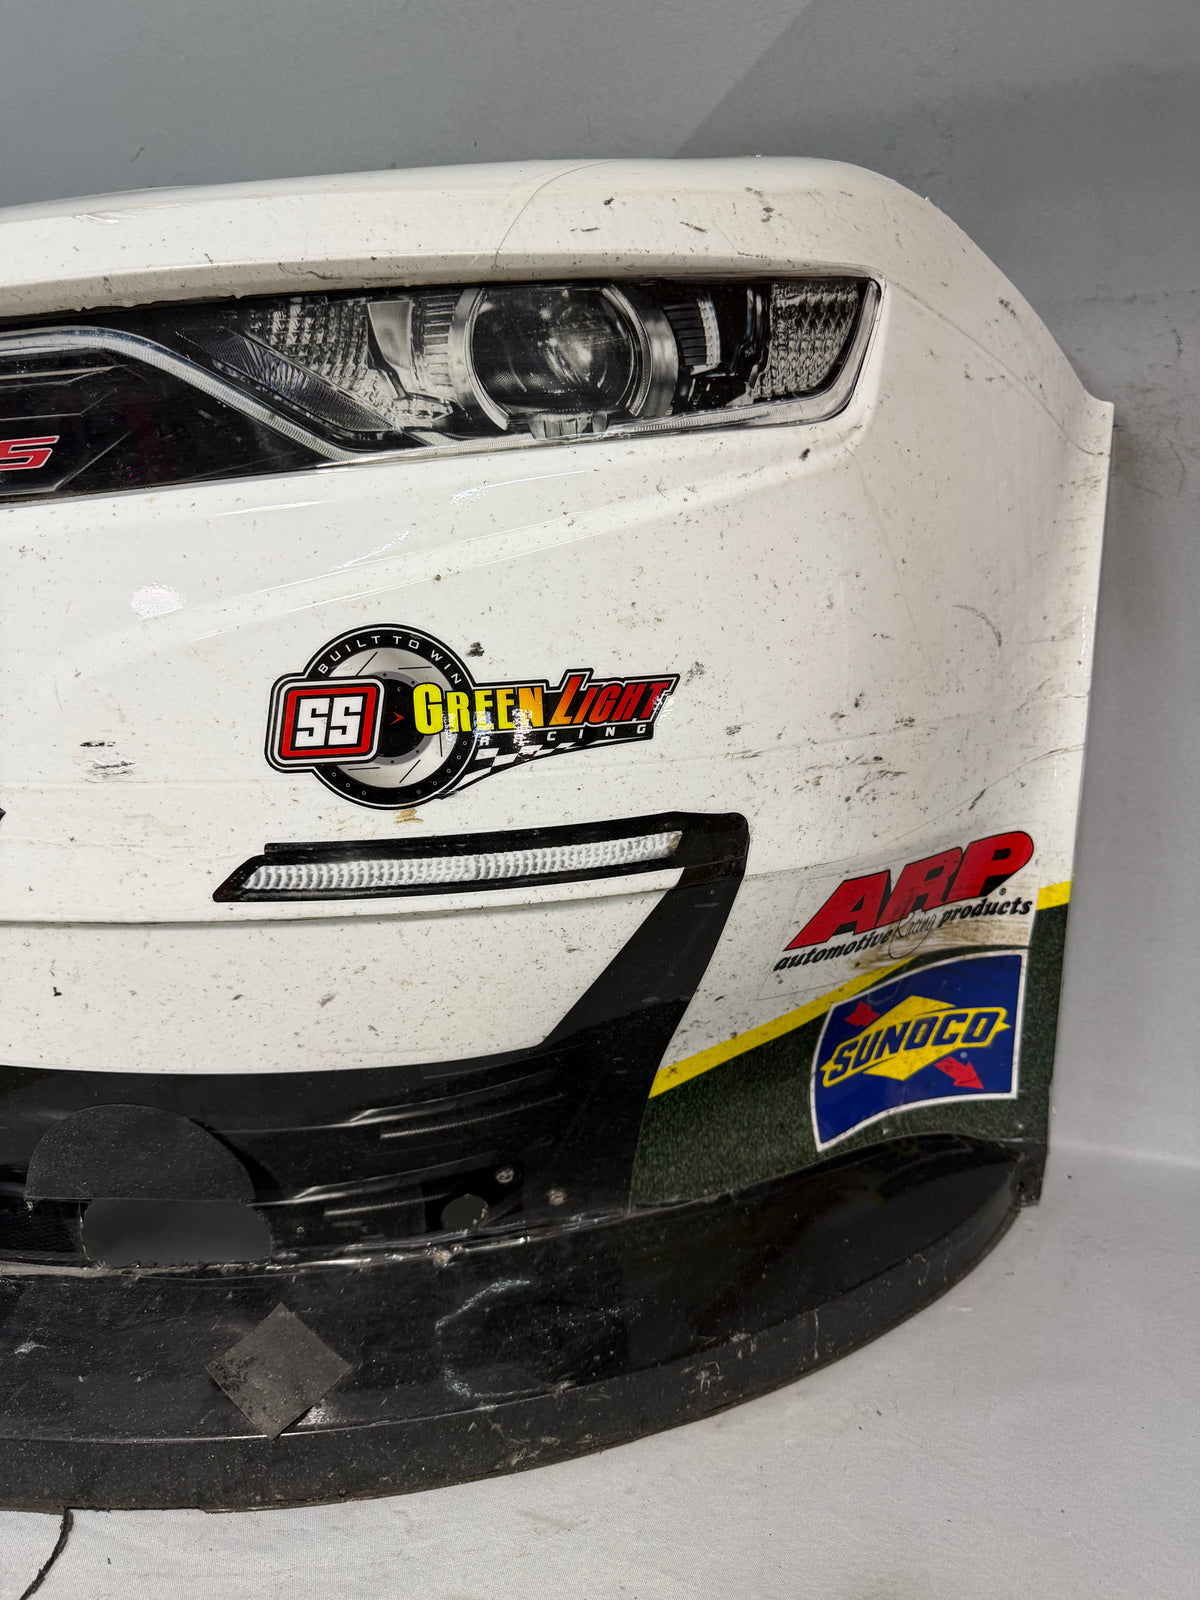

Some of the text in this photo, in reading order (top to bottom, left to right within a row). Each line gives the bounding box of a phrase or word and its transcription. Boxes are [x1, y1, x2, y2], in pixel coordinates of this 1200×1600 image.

[317, 635, 462, 684] BUILT TO WIN
[295, 696, 364, 748] SS
[783, 831, 1034, 951] ARP
[773, 928, 894, 972] automotive
[937, 897, 1032, 928] products
[833, 1011, 1000, 1076] SUNOCO
